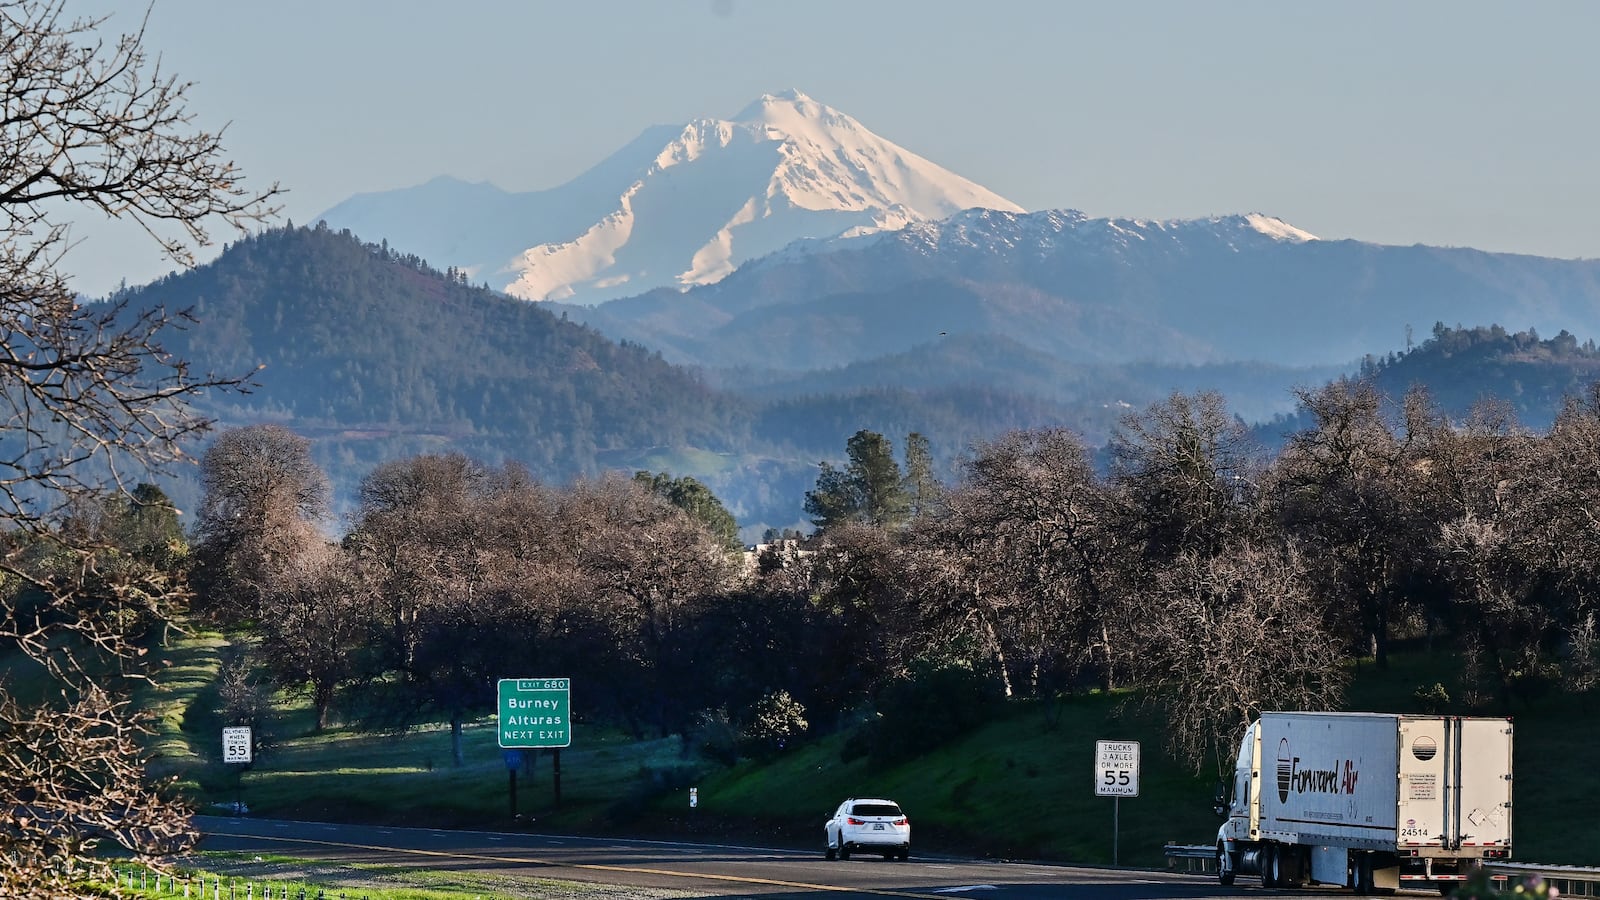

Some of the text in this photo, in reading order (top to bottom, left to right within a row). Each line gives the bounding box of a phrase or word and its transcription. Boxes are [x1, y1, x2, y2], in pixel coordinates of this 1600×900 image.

[508, 698, 559, 711] Burney
[508, 715, 561, 725] Alturas
[504, 731, 565, 739] NEXT EXIT
[229, 745, 246, 756] 55
[1110, 753, 1133, 761] AXLES
[1104, 770, 1130, 786] 55
[1291, 757, 1359, 795] Forward Air
[1401, 828, 1428, 837] 24514
